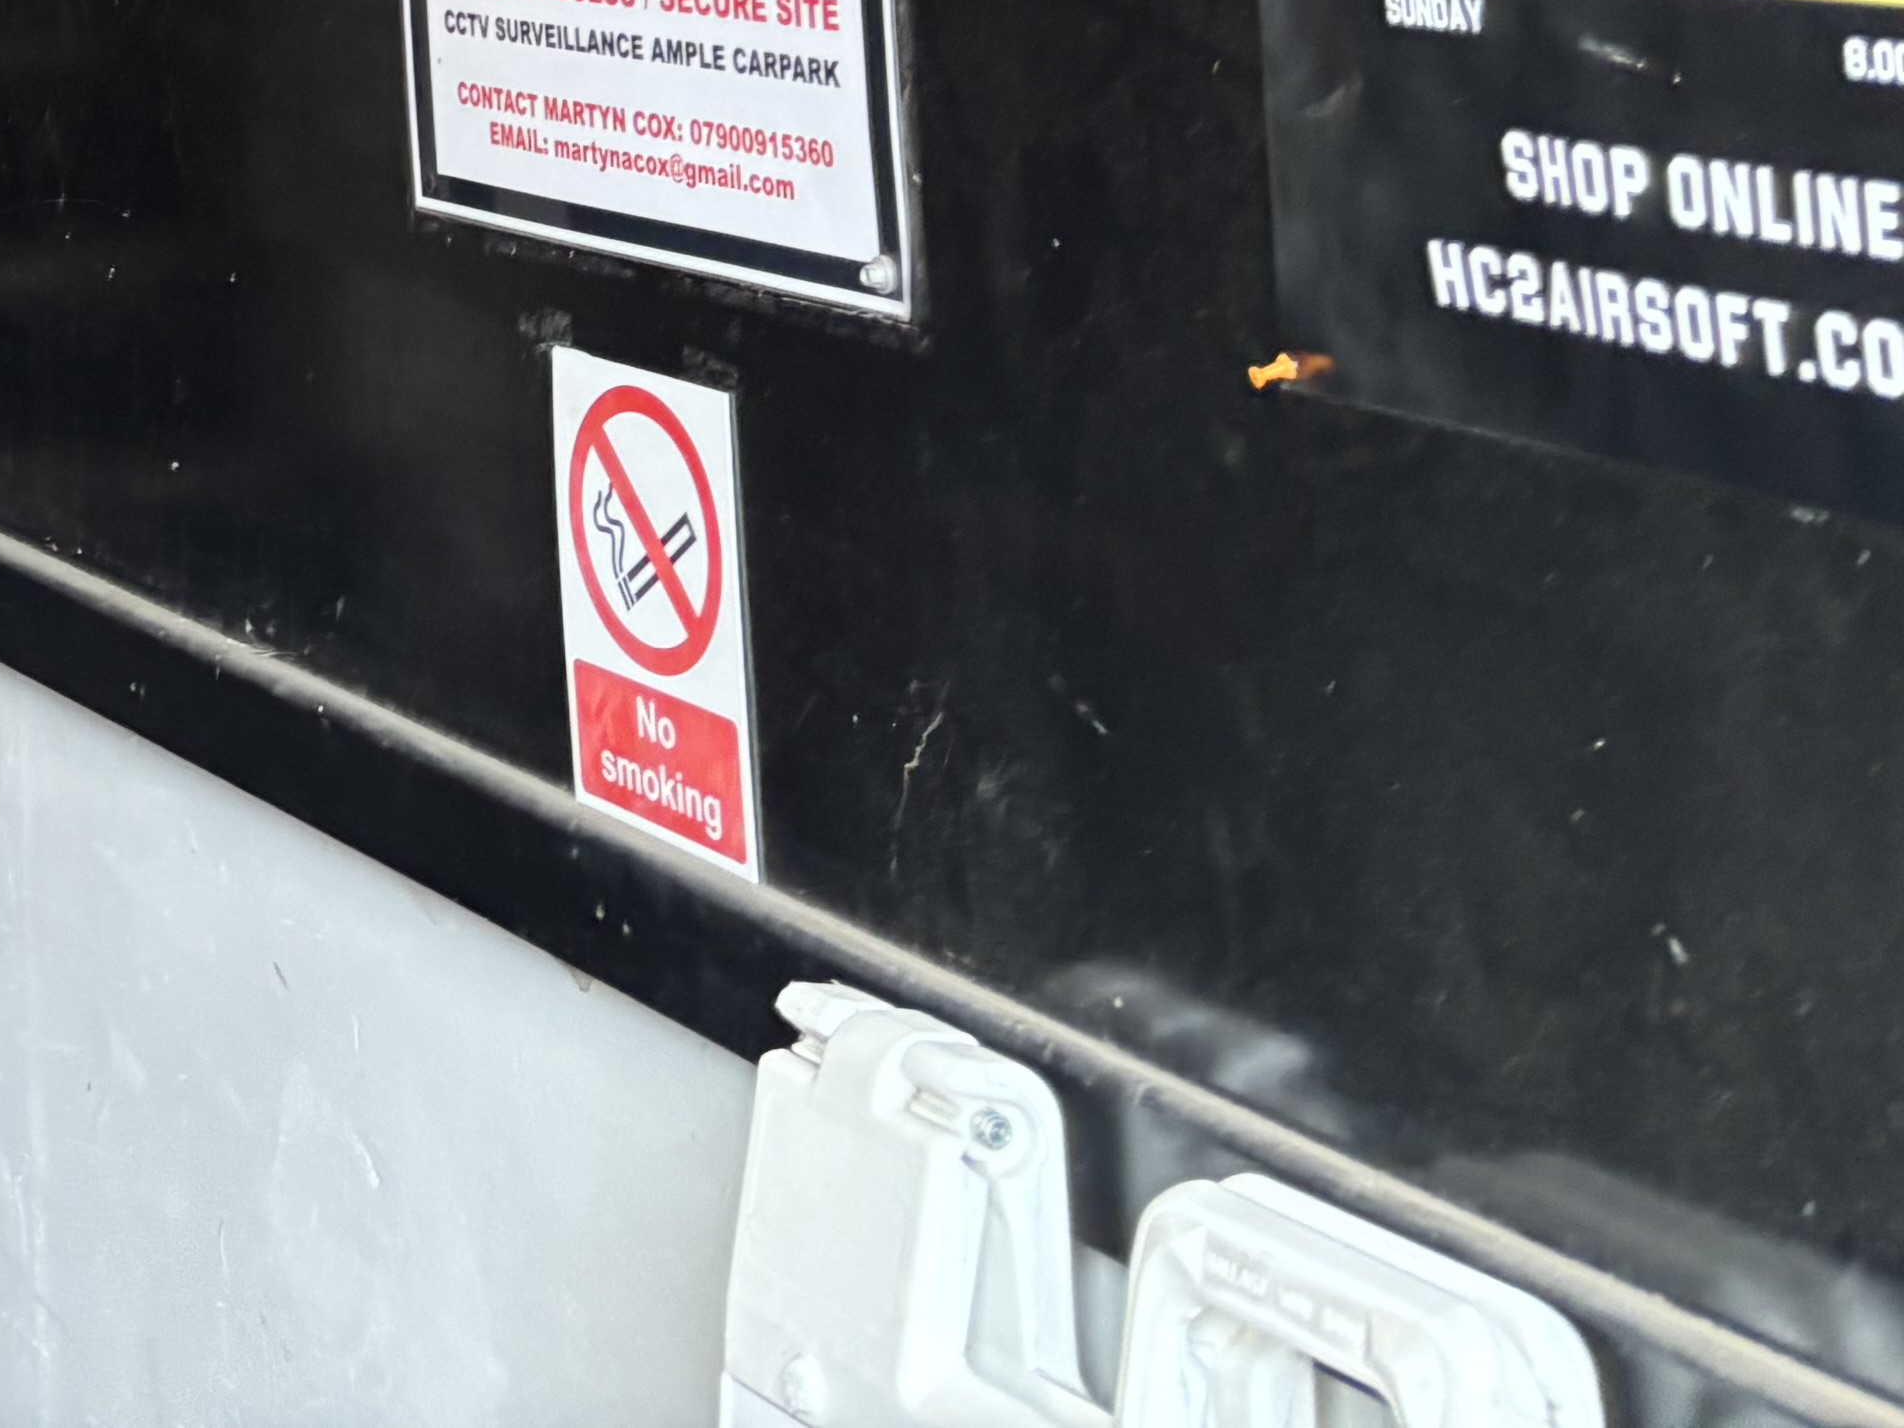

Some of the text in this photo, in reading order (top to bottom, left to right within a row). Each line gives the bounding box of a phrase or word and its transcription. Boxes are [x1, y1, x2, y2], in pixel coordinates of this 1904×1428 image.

[444, 9, 842, 89] CCTV SURVEILLANCE AMPLE CARPARK
[457, 81, 835, 168] CONTACT MARTYN COX: 07900915360
[490, 121, 796, 201] EMAIL: martynacox@gmail.com
[1501, 128, 1904, 262] SHOP ONLINE
[1427, 239, 1904, 400] HC2AIRSOFT.CO
[635, 695, 676, 749] No
[600, 749, 722, 841] smoking
